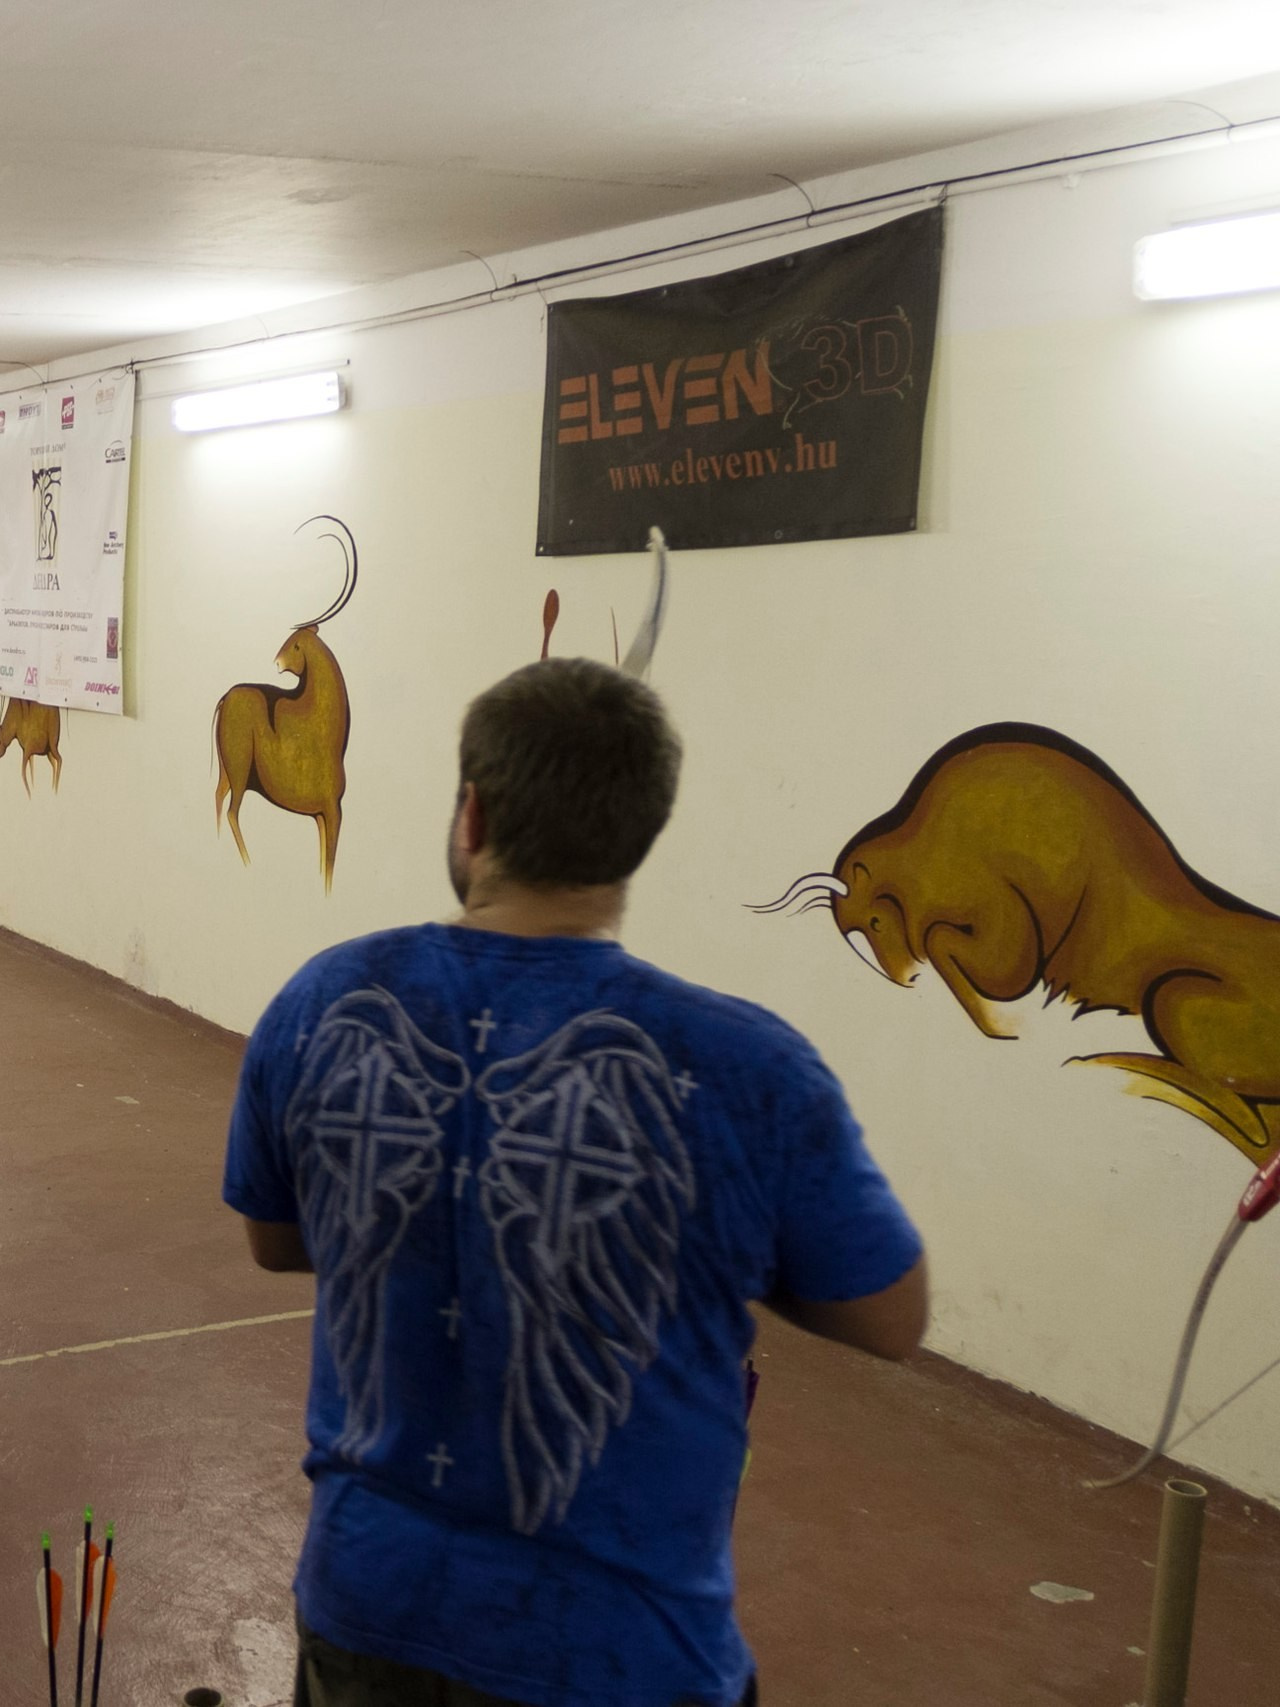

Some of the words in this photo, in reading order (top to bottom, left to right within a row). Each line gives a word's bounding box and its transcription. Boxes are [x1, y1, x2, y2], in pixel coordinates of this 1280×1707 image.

[558, 341, 774, 444] ELEVEN
[800, 314, 914, 401] 3D
[608, 432, 838, 493] www.elevenv.hu
